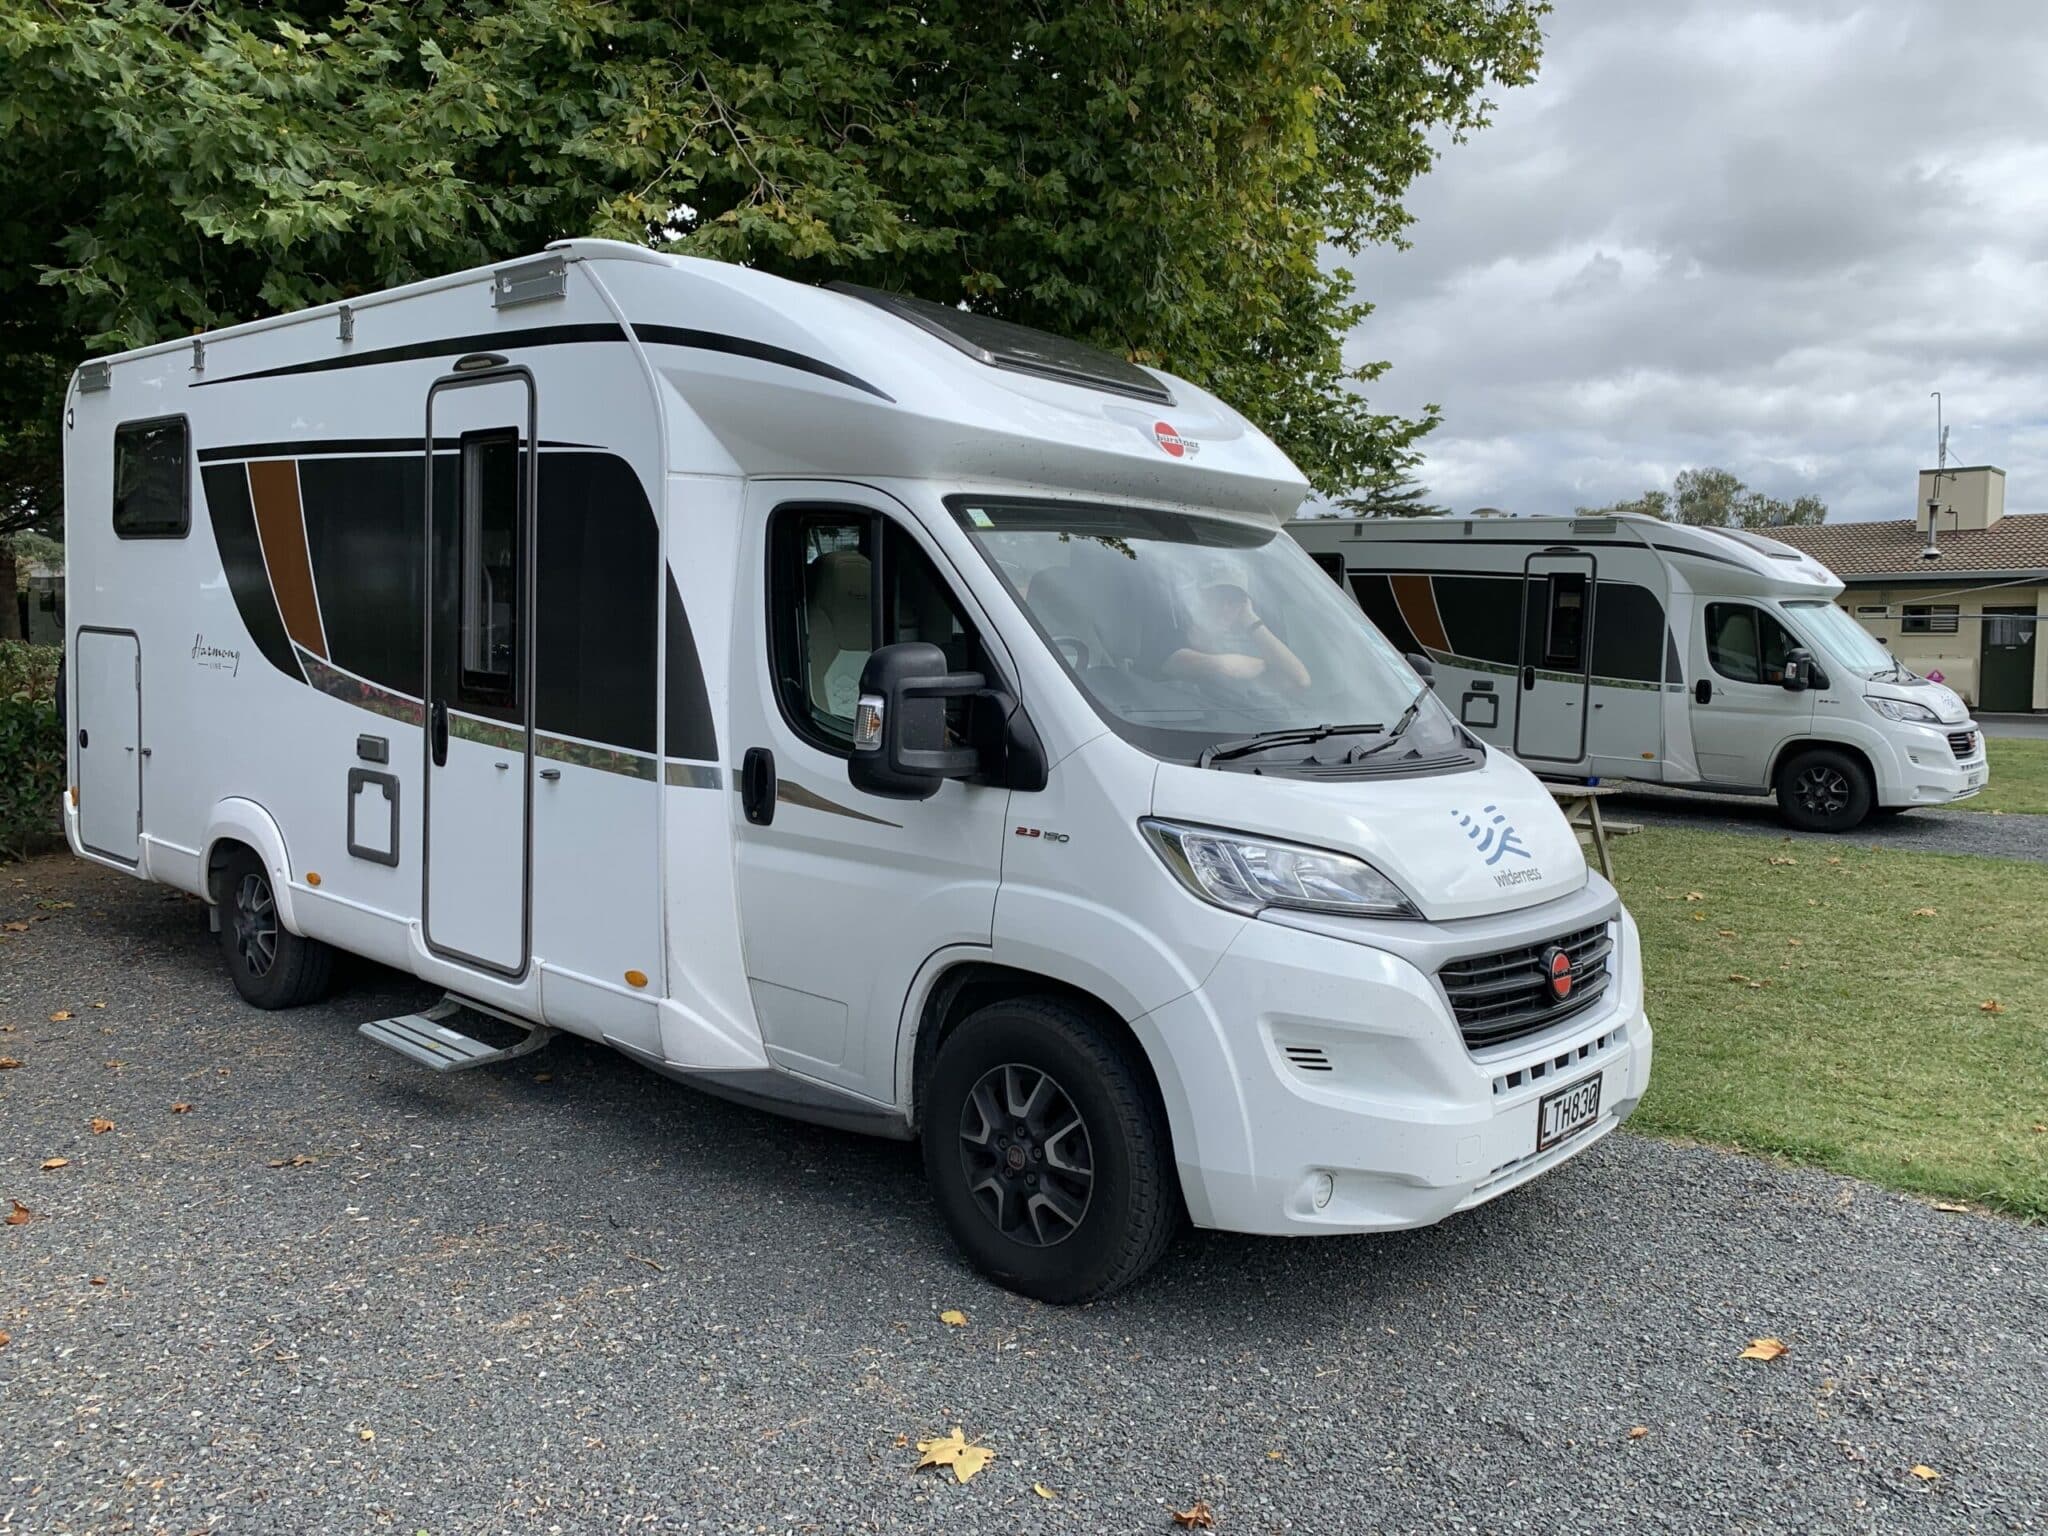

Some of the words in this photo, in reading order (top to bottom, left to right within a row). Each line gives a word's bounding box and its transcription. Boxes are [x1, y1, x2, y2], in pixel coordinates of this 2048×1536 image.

[1043, 831, 1070, 843] 150
[1494, 867, 1542, 887] wilderness
[1543, 1083, 1598, 1138] LTH830
